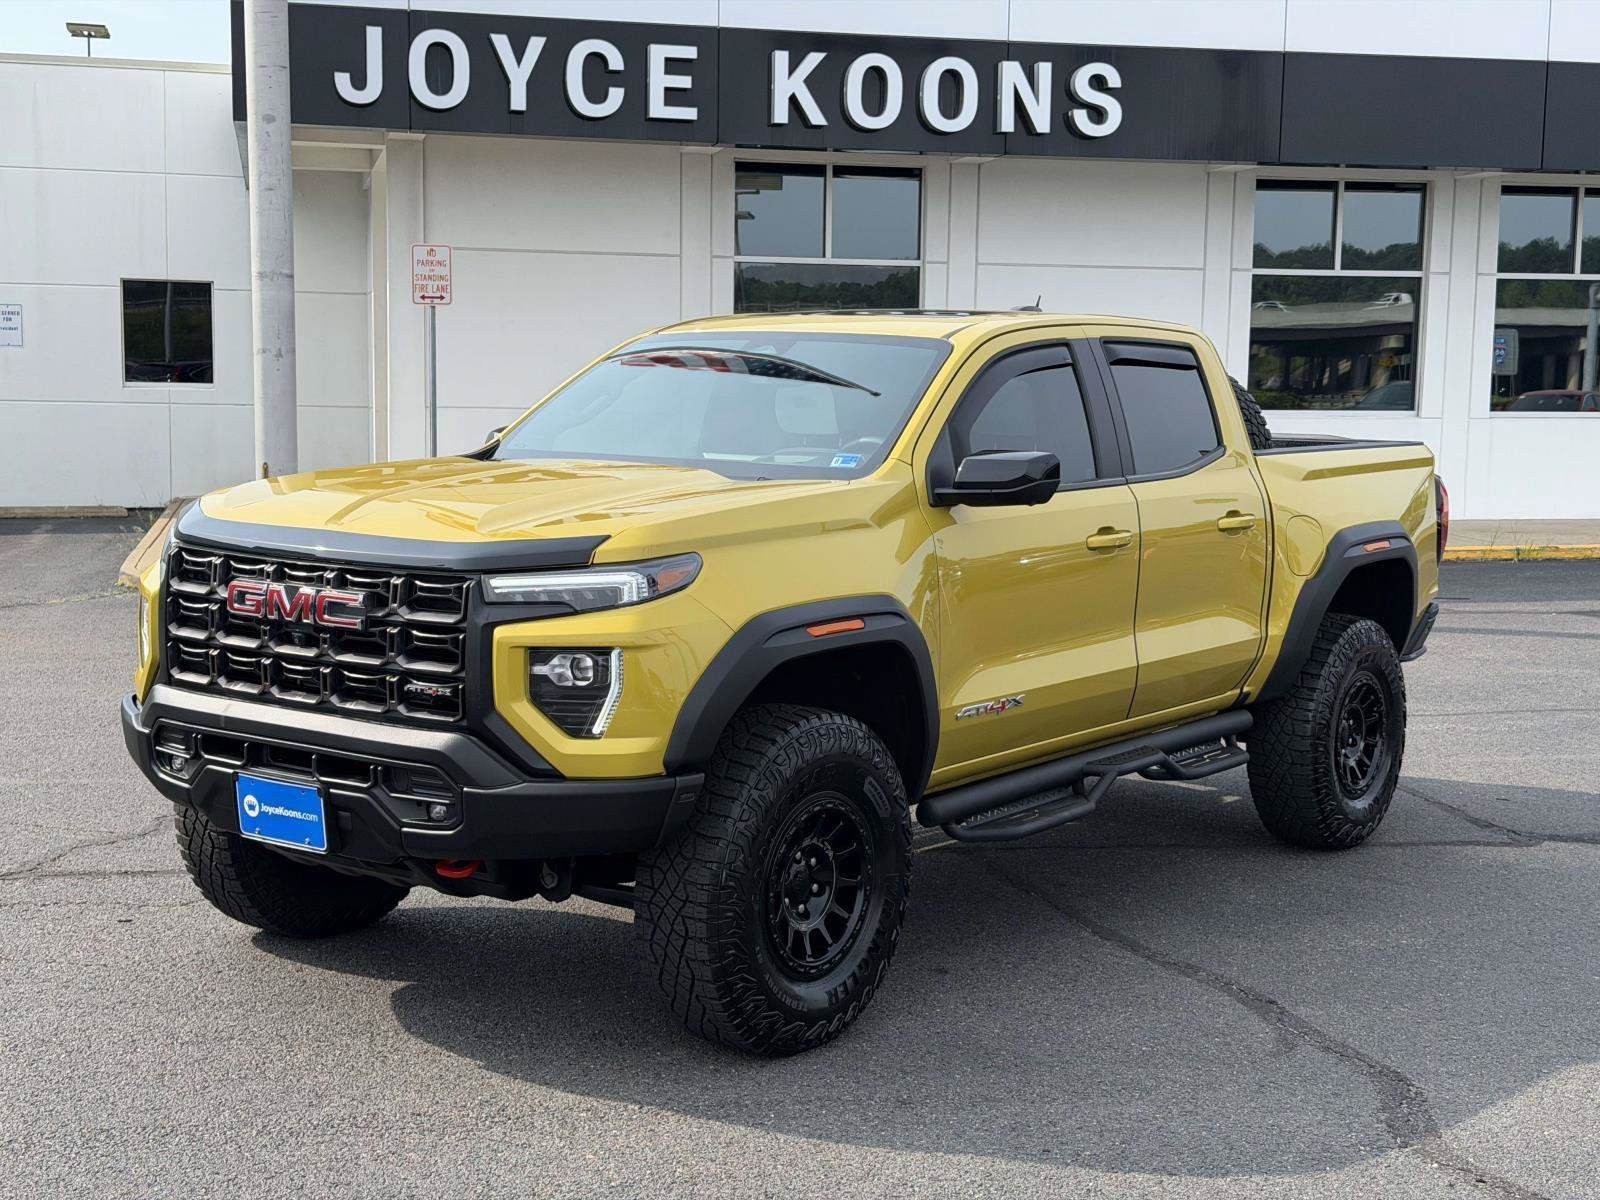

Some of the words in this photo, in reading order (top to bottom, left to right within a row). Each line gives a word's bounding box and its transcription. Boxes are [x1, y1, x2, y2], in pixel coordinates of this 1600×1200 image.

[333, 25, 698, 120] JOYCE
[769, 49, 1123, 138] KOONS
[426, 248, 437, 257] NO
[416, 259, 447, 268] PARKING
[414, 273, 449, 282] STANDING
[414, 284, 429, 293] FIRE
[432, 284, 449, 294] LANE
[227, 578, 368, 631] GMC
[404, 683, 453, 697] AT4X
[953, 694, 1025, 720] AT4X
[260, 802, 319, 822] JoyceKoons.com
